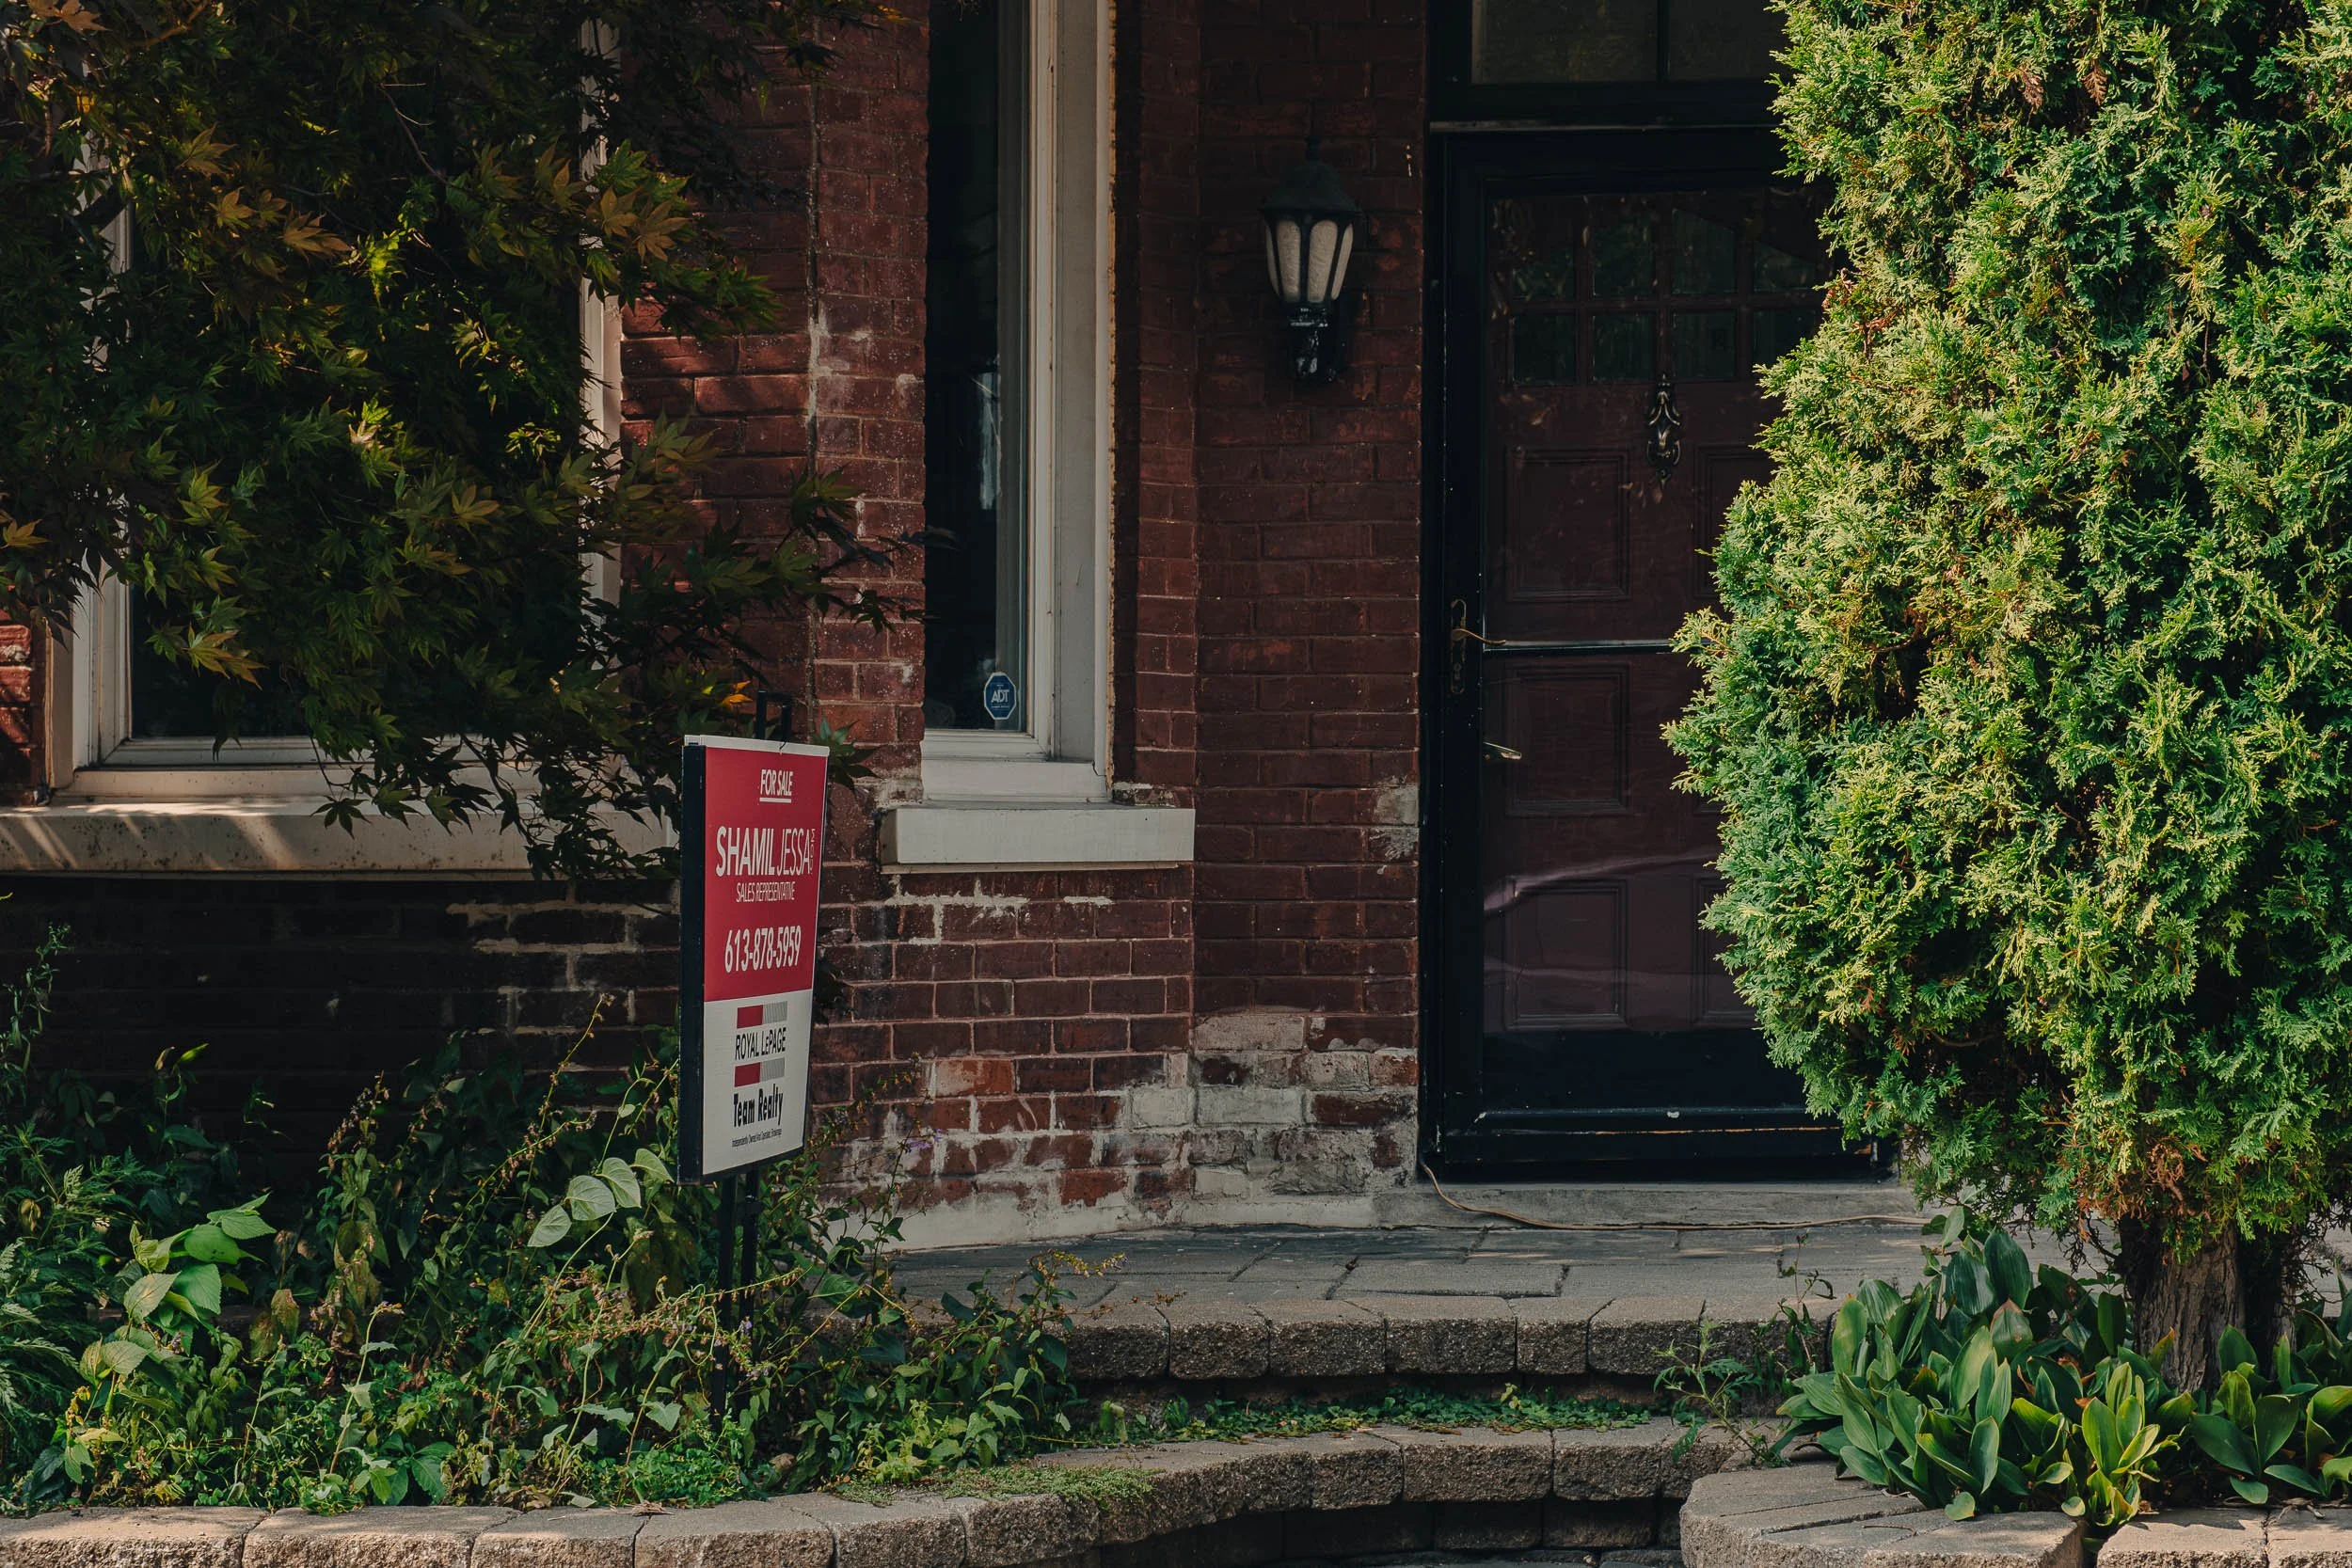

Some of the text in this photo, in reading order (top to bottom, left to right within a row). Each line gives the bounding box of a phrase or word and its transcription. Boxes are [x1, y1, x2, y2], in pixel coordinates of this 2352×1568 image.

[991, 689, 1009, 703] ADT
[760, 768, 794, 797] FOR SALE
[716, 826, 810, 877] SHAMIL JESSA
[736, 881, 796, 903] SALES REPRESENTATIVE
[724, 925, 802, 974] 613-878-5959
[735, 1034, 760, 1061] ROYAL
[733, 1083, 784, 1128] Team Realty
